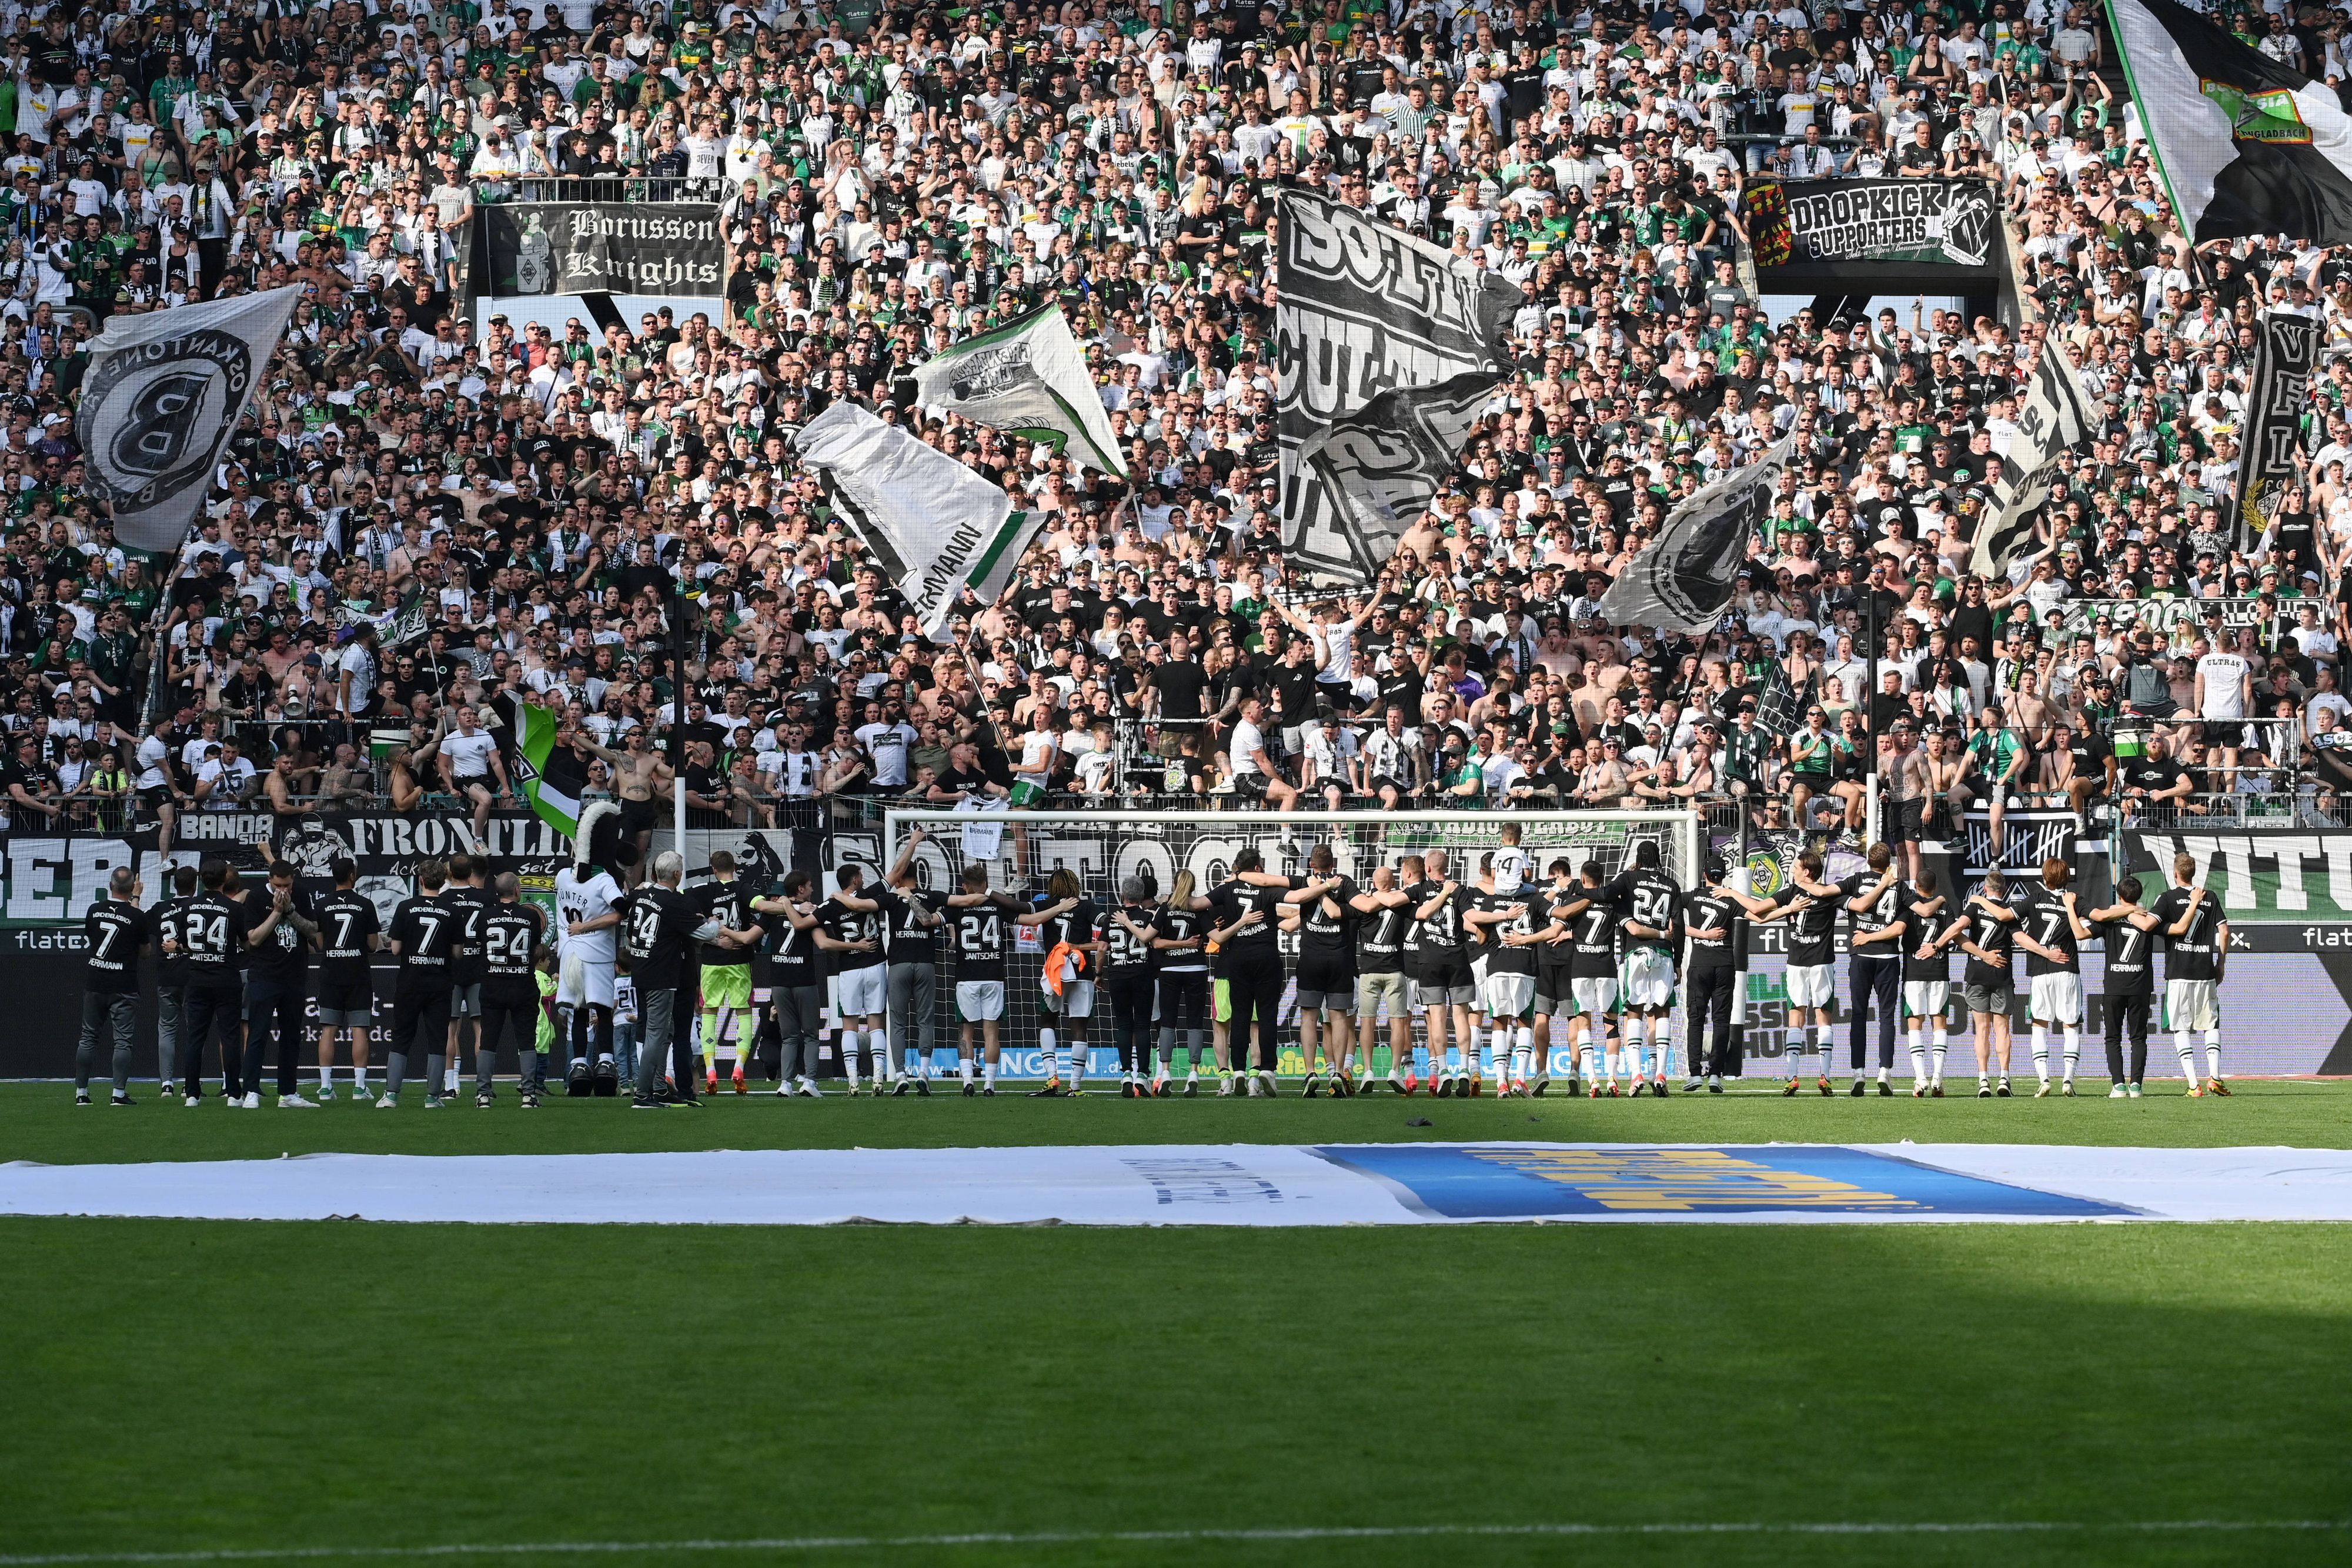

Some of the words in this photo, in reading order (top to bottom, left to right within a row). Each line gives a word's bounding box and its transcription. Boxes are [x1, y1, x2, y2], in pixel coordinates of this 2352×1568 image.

[696, 155, 714, 163] JEVER
[1435, 189, 1460, 197] flatex
[1792, 184, 1943, 233] DROPKICK
[569, 209, 715, 242] Borussen
[1809, 216, 1927, 257] SUPPORTERS
[362, 265, 384, 273] Diebels
[565, 252, 719, 286] Knights
[2196, 601, 2323, 625] MALOHER
[2207, 658, 2241, 667] ULTRAS
[181, 814, 274, 840] BANDA
[1238, 897, 1254, 918] 7
[1633, 887, 1671, 929] 24
[1857, 884, 1898, 924] 24
[334, 912, 353, 948] 7
[1054, 917, 1071, 942] 7
[1171, 920, 1190, 941] 7
[1306, 921, 1340, 933] HERRMANN
[1373, 909, 1395, 944] 7
[1585, 910, 1606, 944] 7
[1699, 905, 1719, 932] 7
[2041, 912, 2061, 945] 7
[96, 921, 120, 959] 7
[186, 913, 229, 952] 24
[417, 916, 440, 955] 7
[896, 930, 929, 940] HERRMANN
[960, 914, 1001, 951] 24
[1921, 918, 1939, 945] 7
[1979, 919, 1998, 951] 7
[189, 952, 225, 963] JANTSCHKE
[326, 949, 362, 958] HERRMANN
[486, 927, 532, 965] 24
[964, 951, 1000, 961] JANTSCHKE
[1364, 941, 1398, 953] HERRMANN
[1576, 944, 1609, 953] HERRMANN
[2119, 927, 2140, 963] 7
[2174, 942, 2210, 953] HERRMANN
[88, 958, 123, 970] HERRMANN
[409, 955, 445, 965] HERRMANN
[487, 965, 529, 974] JANTSCHKE
[772, 954, 804, 964] HERRMANN
[2110, 963, 2143, 972] HERRMANN
